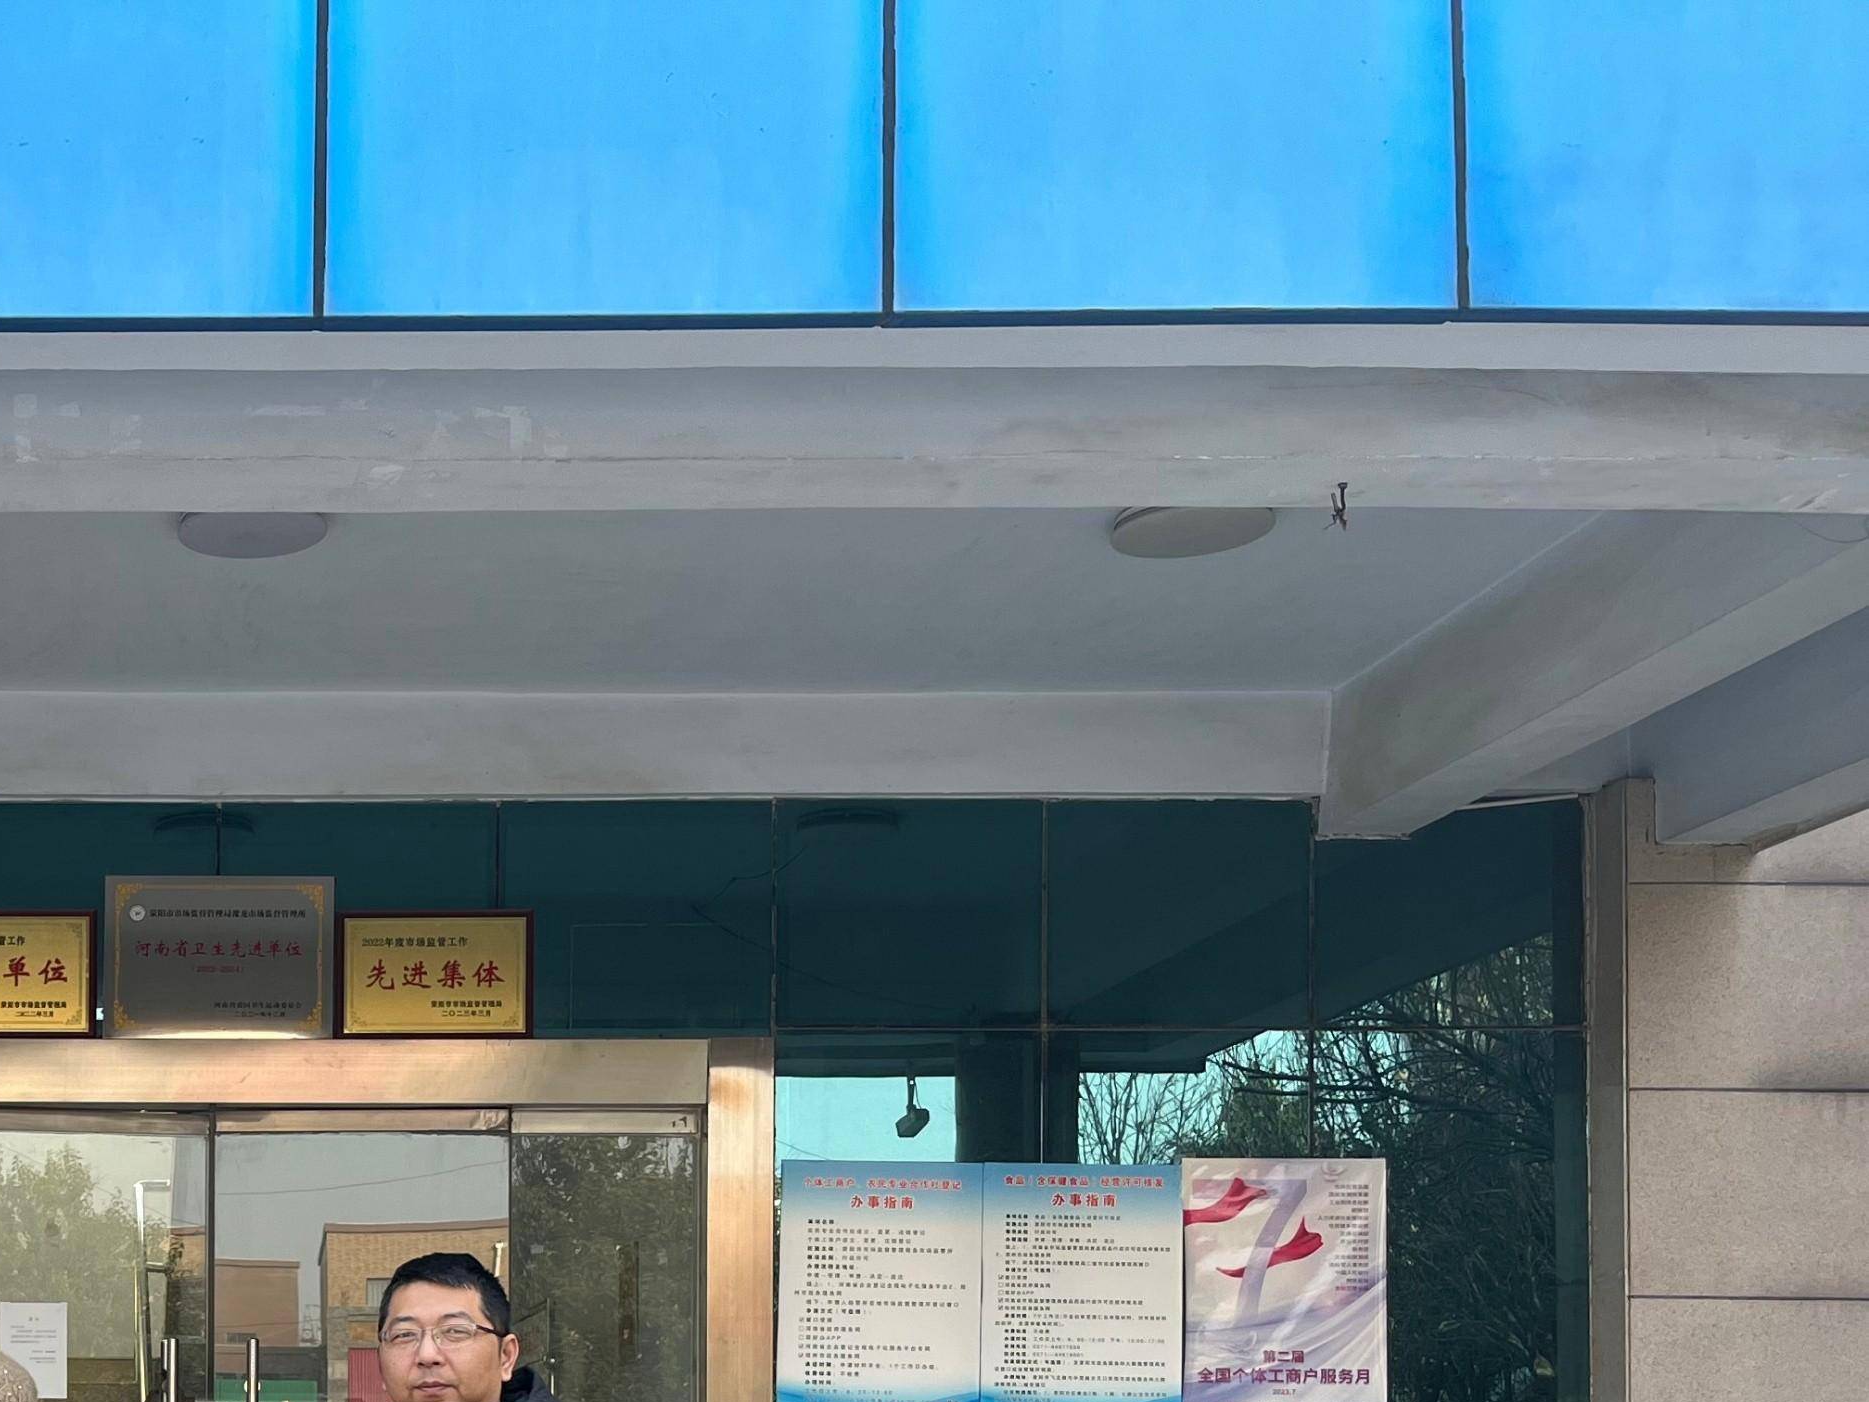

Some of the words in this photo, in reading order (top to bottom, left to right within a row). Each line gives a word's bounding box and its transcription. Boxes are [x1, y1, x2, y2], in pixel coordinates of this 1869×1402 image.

[134, 940, 303, 959] 河南省卫生先进单位
[365, 959, 506, 990] 先进集体
[850, 1195, 914, 1210] 办事指南
[1052, 1193, 1117, 1207] 办事指南
[1262, 1350, 1305, 1364] 第二届
[1197, 1367, 1371, 1385] 全国个体工商户服务月
